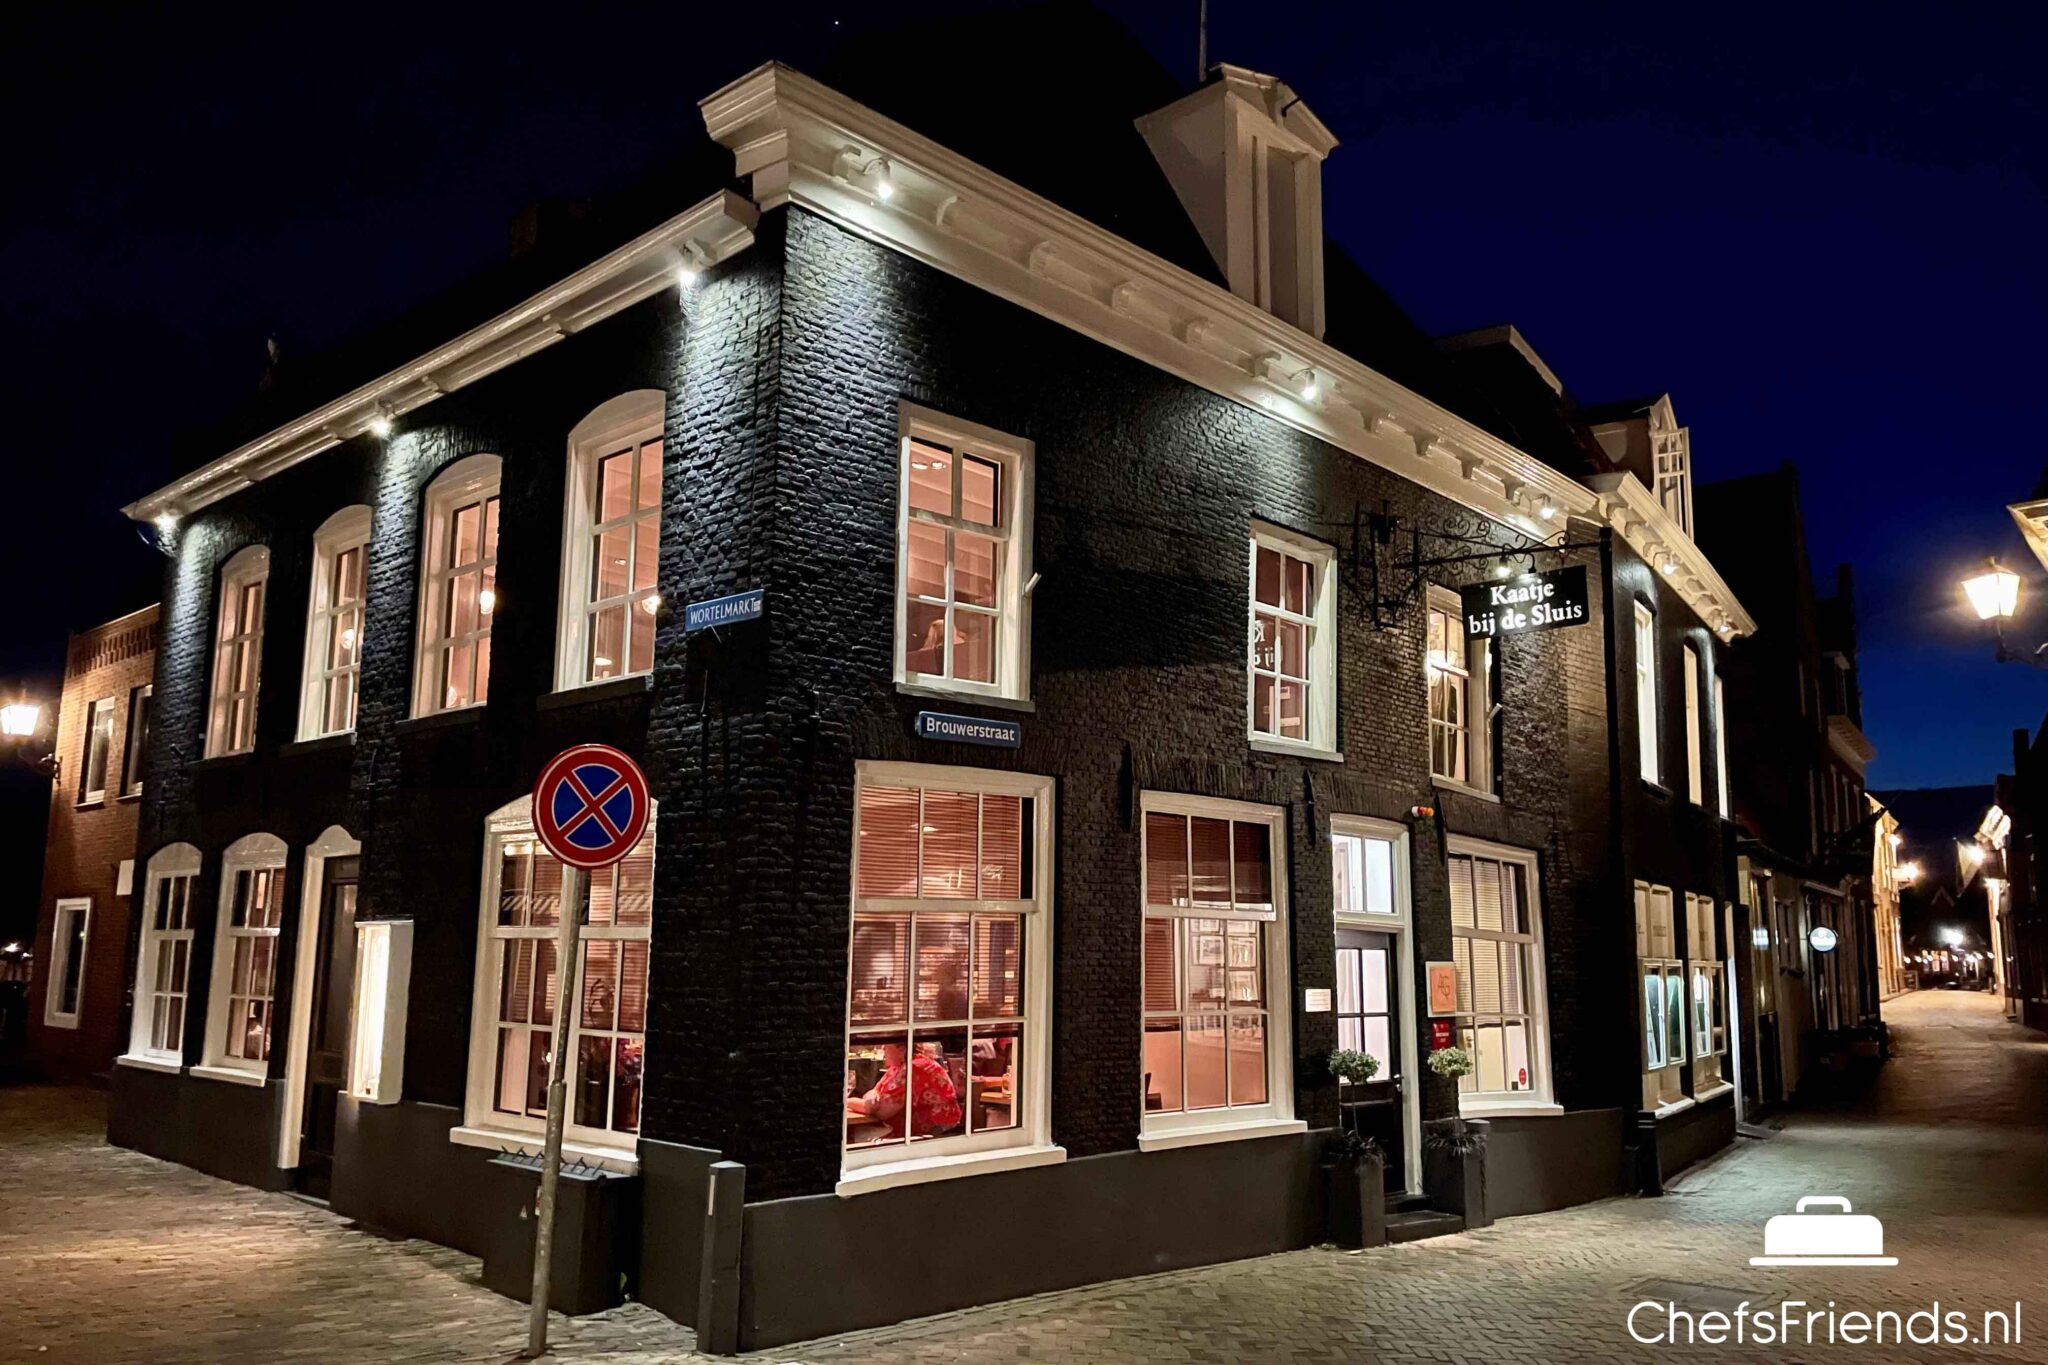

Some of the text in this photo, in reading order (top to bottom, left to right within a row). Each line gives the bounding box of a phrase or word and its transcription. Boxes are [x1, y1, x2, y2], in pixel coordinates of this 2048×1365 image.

[1490, 579, 1554, 605] Kaatje
[690, 597, 756, 624] WORTELMARKT
[1469, 600, 1582, 635] bij de Sluis
[926, 717, 1015, 741] Brouwerstraat
